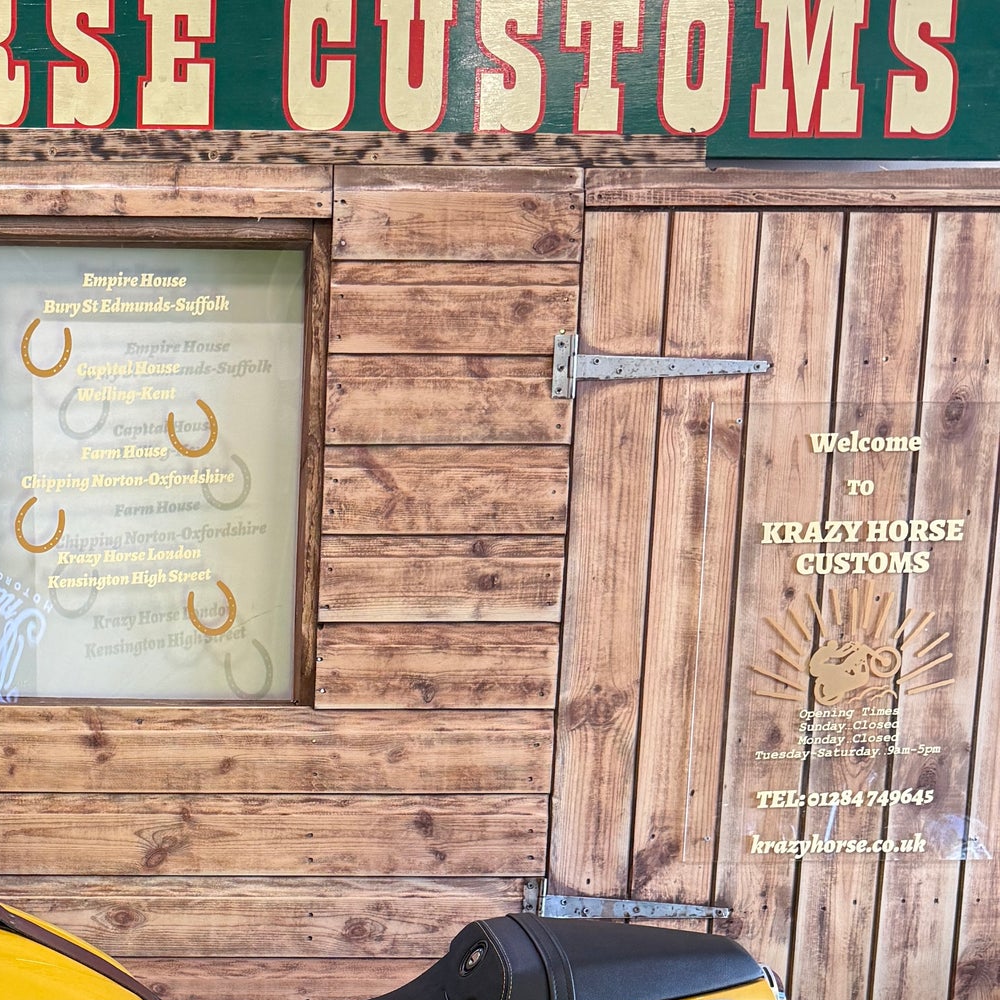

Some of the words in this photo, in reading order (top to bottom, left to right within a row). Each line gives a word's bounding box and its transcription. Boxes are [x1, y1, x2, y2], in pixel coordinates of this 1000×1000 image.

[282, 0, 960, 139] CUSTOMS
[82, 272, 138, 292] Empire
[140, 272, 188, 288] House
[43, 300, 80, 318] Bury
[82, 298, 99, 314] St
[100, 296, 230, 316] Edmunds-Suffolk
[76, 361, 133, 382] Capital
[134, 361, 181, 376] House
[77, 386, 177, 406] Welling-Kent
[80, 446, 121, 461] Farm
[122, 444, 168, 460] House
[810, 430, 922, 454] Welcome
[21, 474, 91, 494] Chipping
[92, 470, 236, 490] Norton-Oxfordshire
[847, 479, 875, 496] TO
[761, 521, 864, 544] KRAZY
[866, 520, 964, 542] HORSE
[57, 550, 102, 567] Krazy
[103, 550, 146, 564] Horse
[148, 546, 202, 561] London
[796, 552, 930, 575] CUSTOMS
[47, 575, 130, 598] Kensington
[130, 571, 167, 587] High
[168, 568, 212, 584] Street
[799, 708, 854, 720] Opening
[862, 706, 900, 717] Times
[867, 788, 934, 805] 749645
[750, 832, 927, 860] krazyhorse.co.uk
